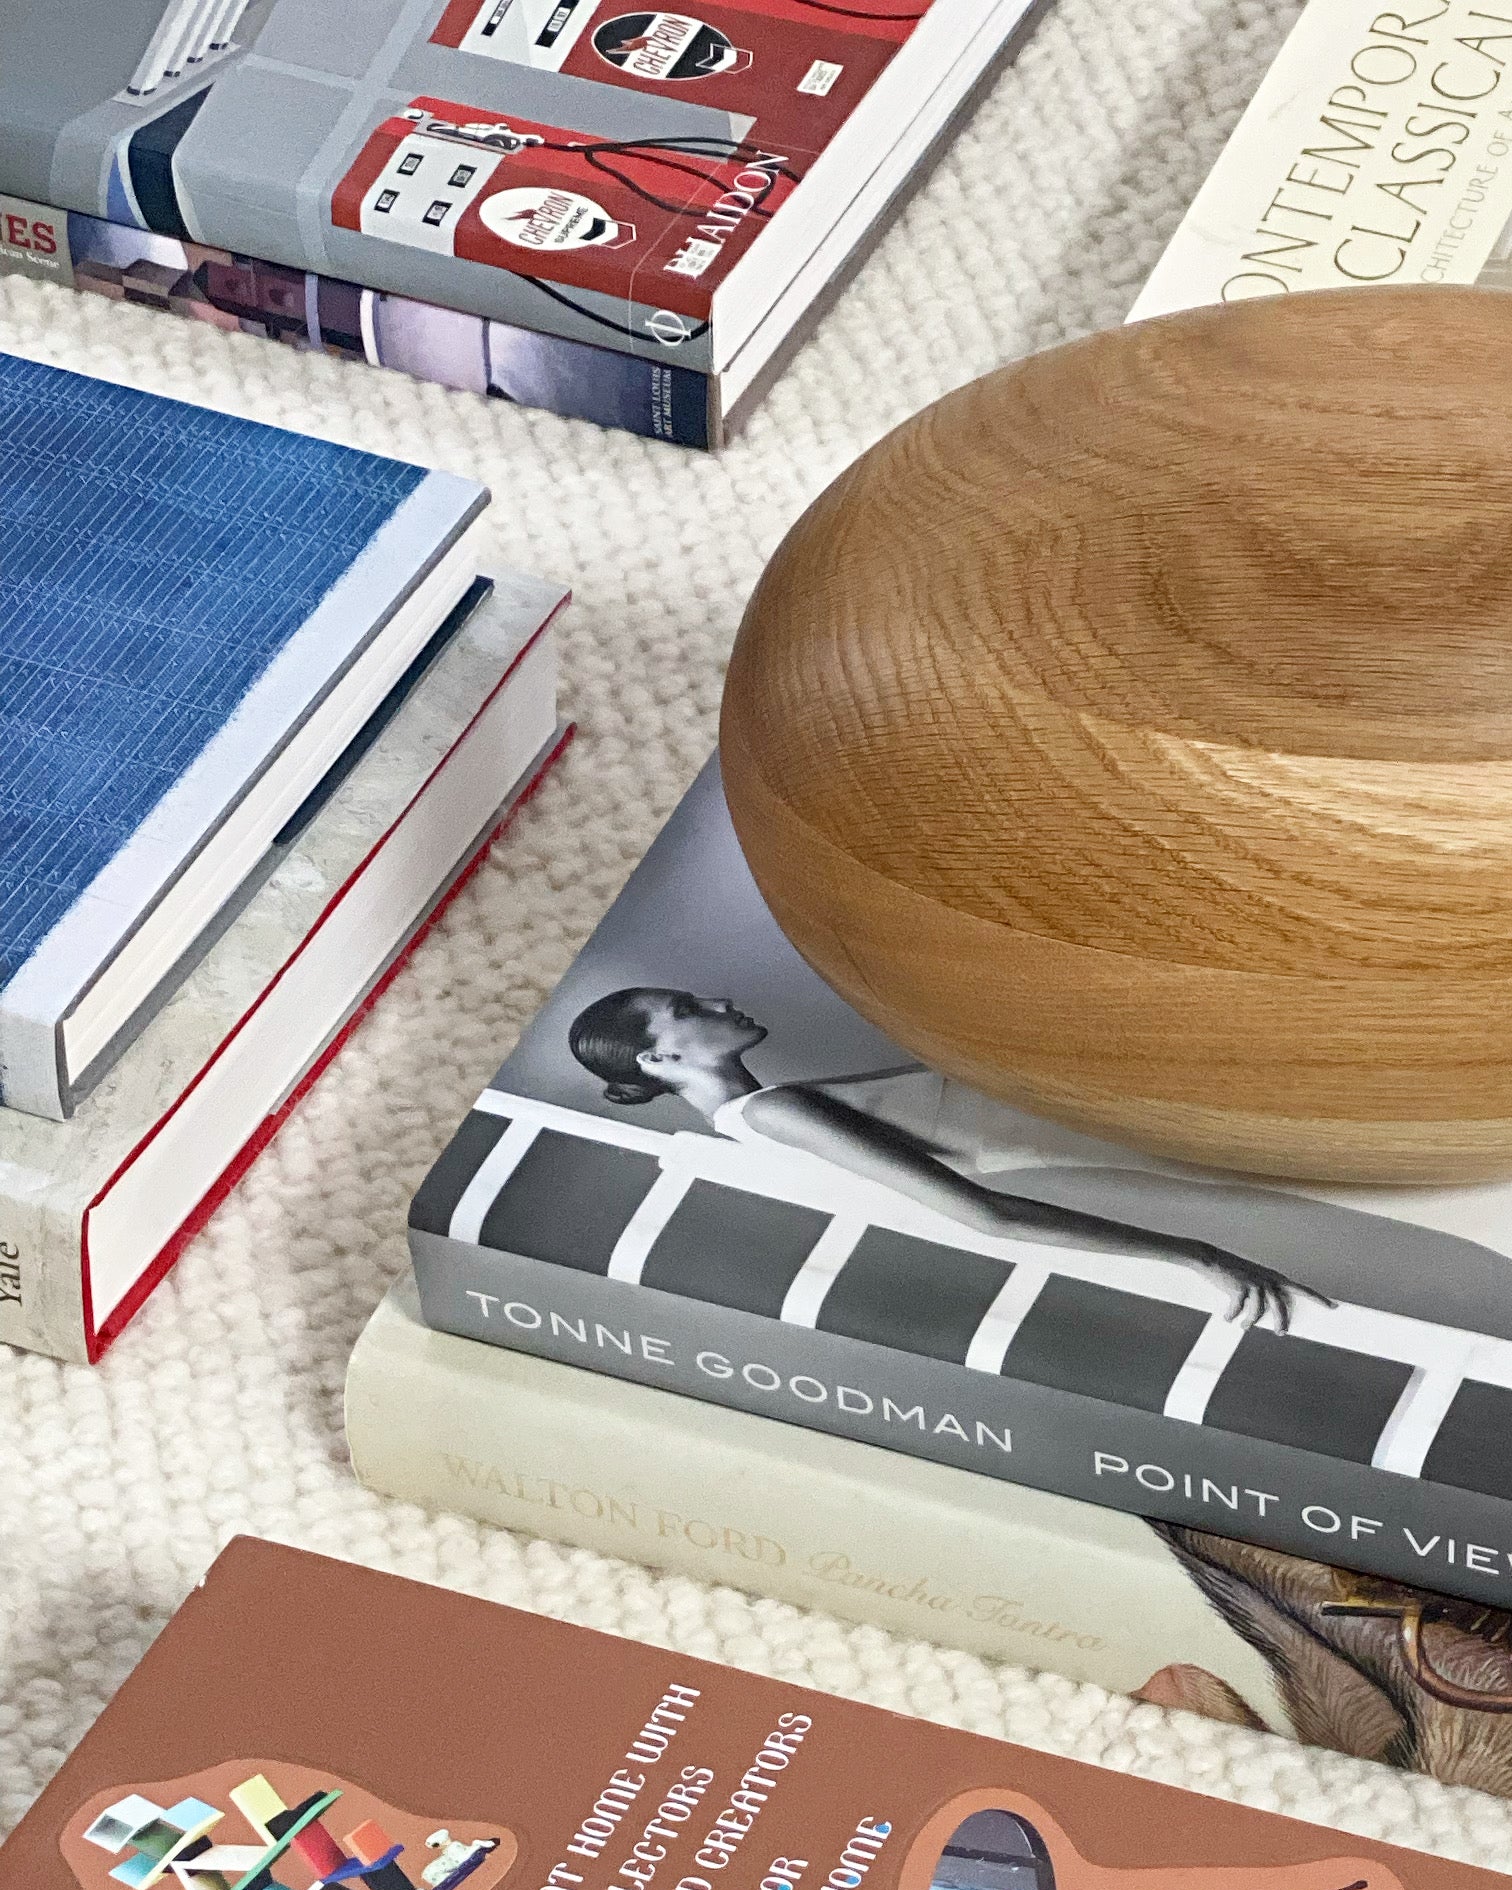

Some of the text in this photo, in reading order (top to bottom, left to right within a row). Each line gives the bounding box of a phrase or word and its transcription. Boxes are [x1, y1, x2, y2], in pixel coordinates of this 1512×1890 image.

[633, 15, 692, 76] CHEVRON
[1221, 0, 1450, 303] ONTEMPOR
[1486, 130, 1512, 157] OF
[0, 211, 57, 254] ES
[519, 191, 574, 245] CHEVRON
[554, 206, 588, 244] SUPREME
[662, 150, 789, 279] PHAIDON
[466, 1290, 675, 1366] TONNE
[696, 1351, 1012, 1453] GOODMAN
[1093, 1449, 1280, 1518] POINT
[1300, 1505, 1385, 1542] OF
[438, 1451, 639, 1528] WALTON
[655, 1508, 787, 1567] FORD
[567, 1768, 646, 1857] HOME
[625, 1683, 701, 1764] WITH
[694, 1712, 812, 1869] CREATORS
